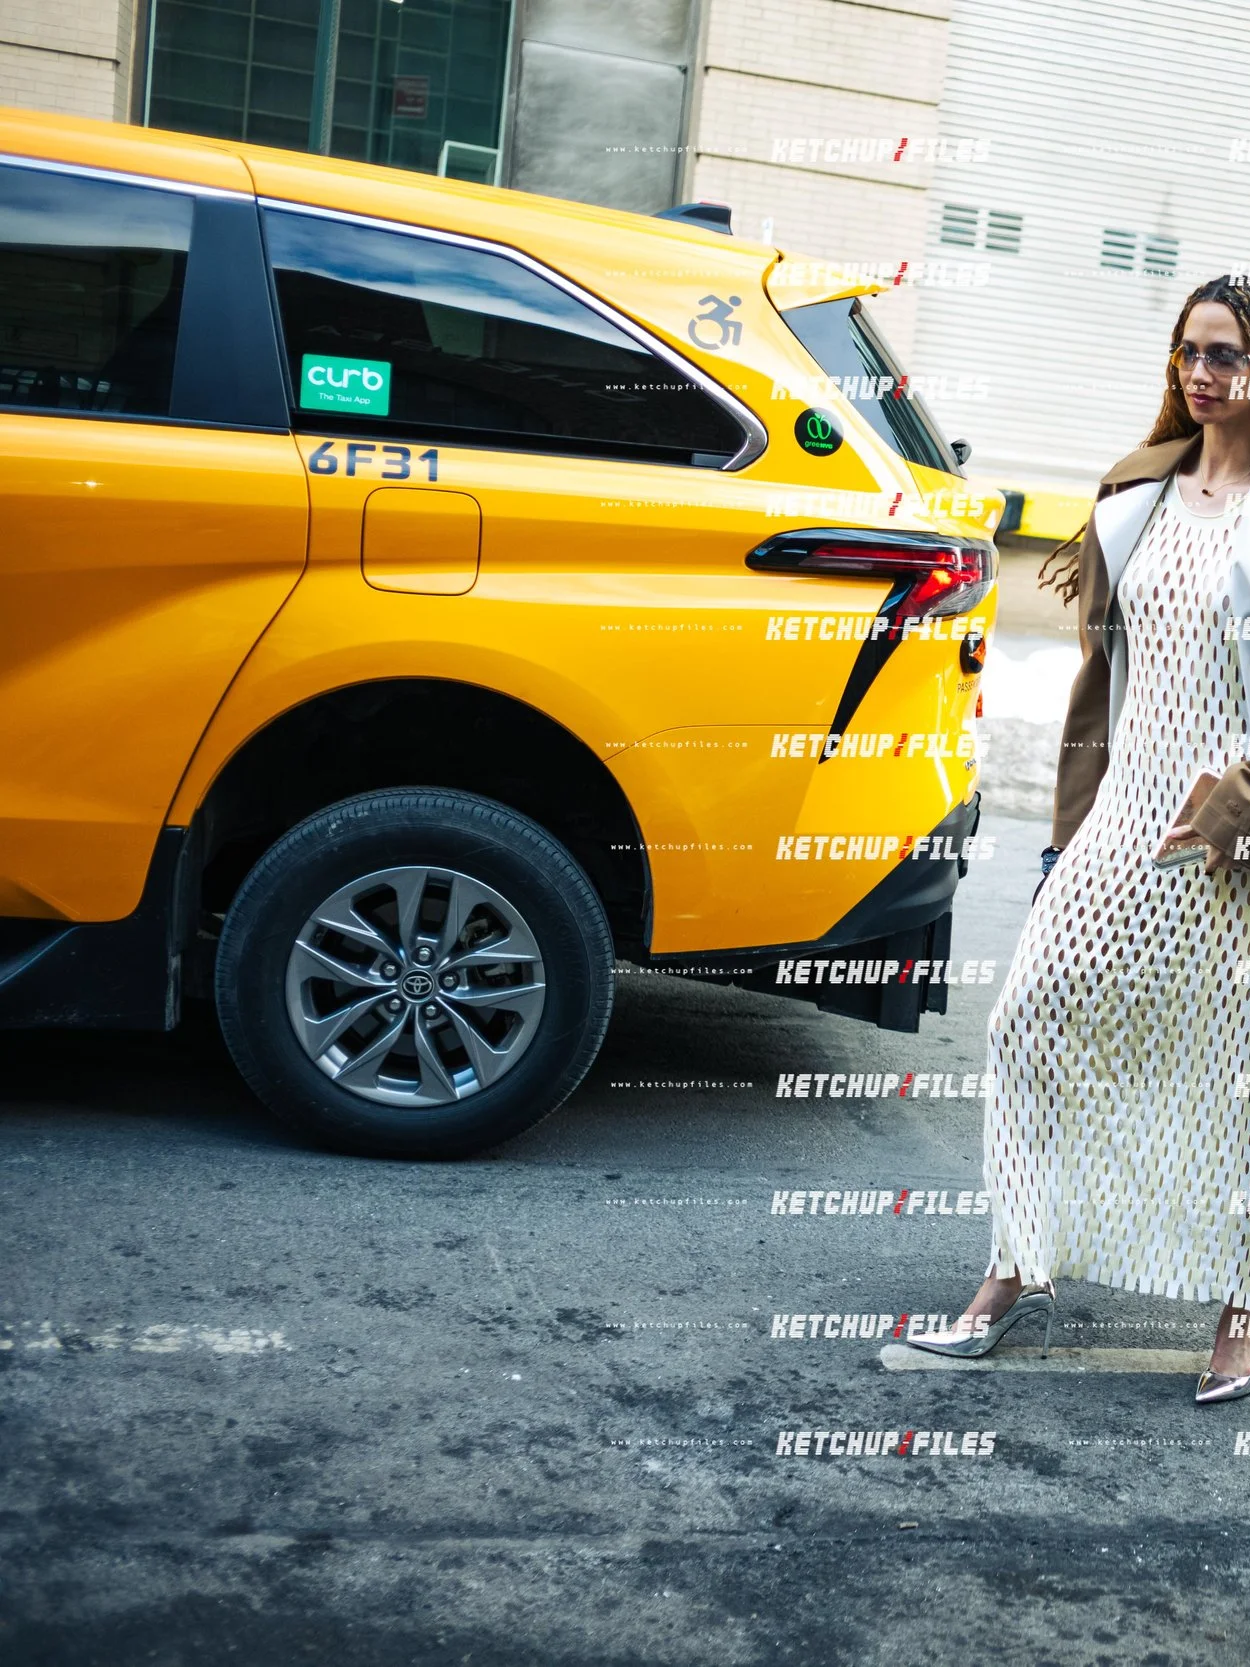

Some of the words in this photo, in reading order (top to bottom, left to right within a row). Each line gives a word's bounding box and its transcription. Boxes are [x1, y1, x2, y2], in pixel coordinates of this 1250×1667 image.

[307, 366, 384, 391] curb
[319, 392, 334, 401] The
[336, 394, 352, 403] Taxi
[353, 396, 371, 405] App
[308, 441, 439, 482] 6F31
